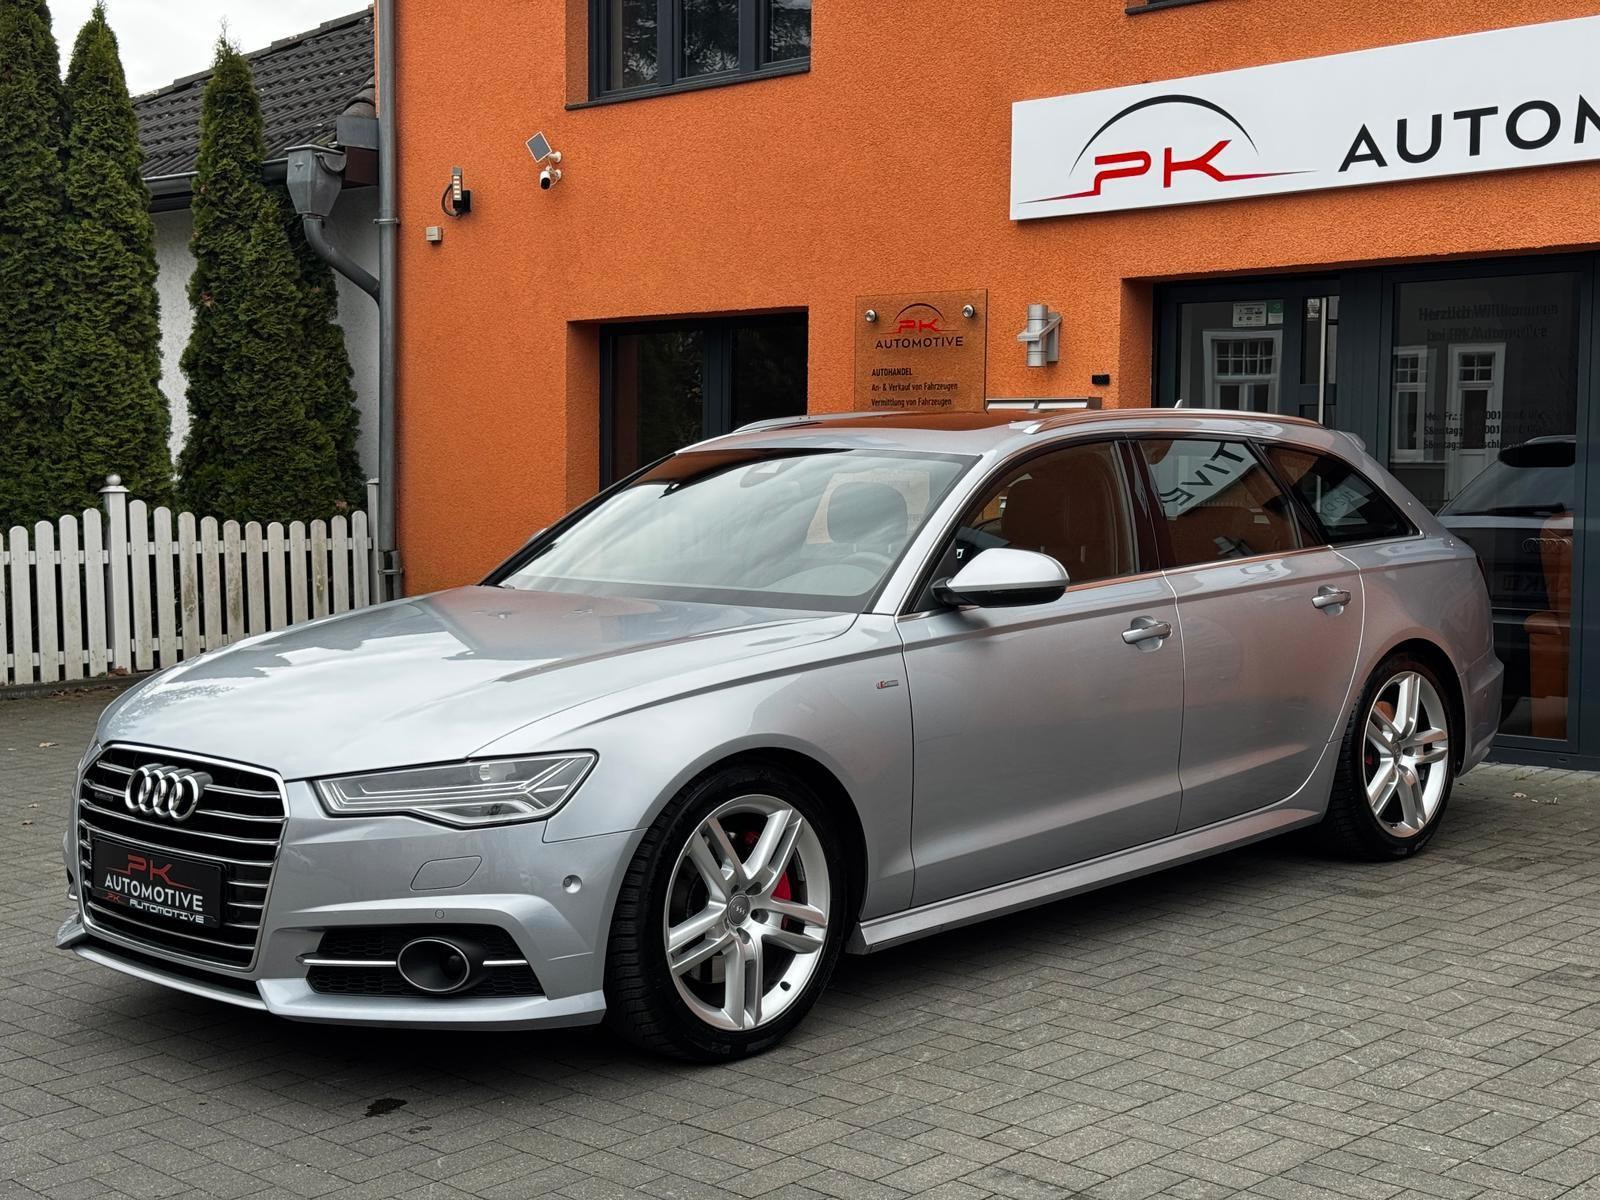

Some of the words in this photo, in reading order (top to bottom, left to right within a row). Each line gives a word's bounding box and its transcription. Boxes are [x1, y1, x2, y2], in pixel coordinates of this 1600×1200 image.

[1090, 139, 1234, 196] PK
[897, 318, 939, 333] PK
[875, 336, 964, 350] AUTOMOTIVE
[871, 367, 913, 377] AUTOHANDEL
[882, 383, 887, 392] &
[888, 382, 911, 391] Verkauf
[923, 381, 958, 392] Fahrzeugen
[871, 398, 905, 408] Vermittlung
[917, 397, 952, 408] Fahrzeugen
[127, 853, 173, 885] PK
[104, 872, 204, 912] AUTOMOTIVE
[129, 898, 205, 924] AUTOMOTIVE
